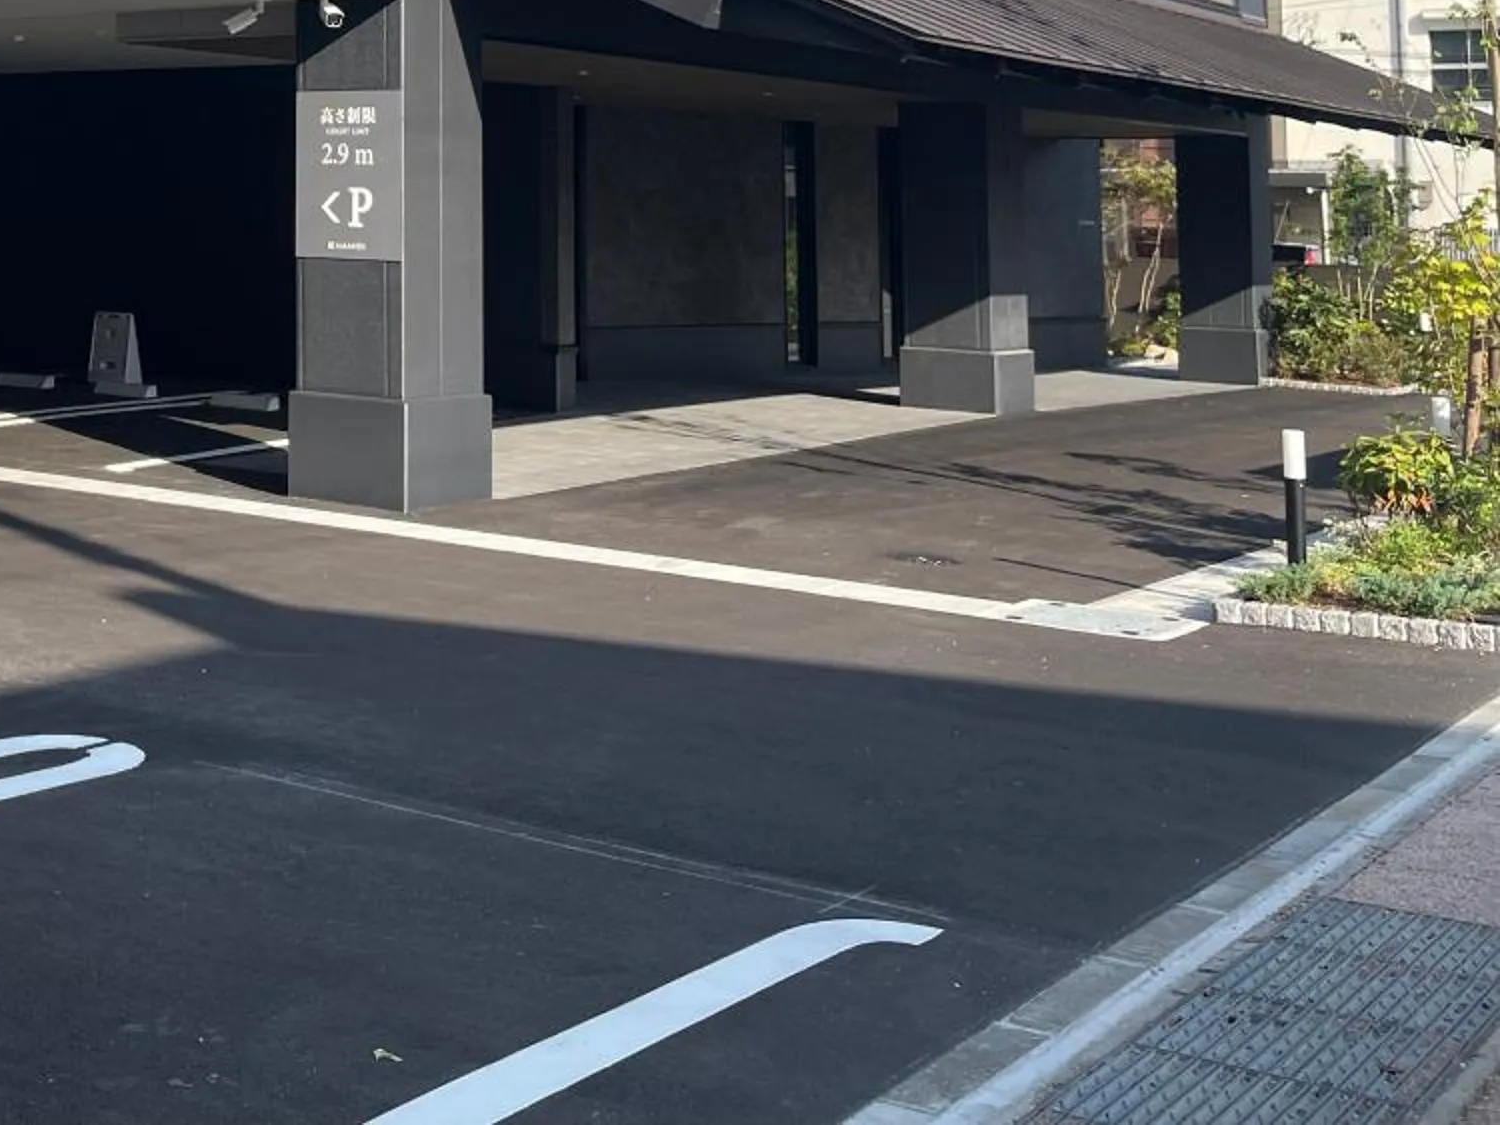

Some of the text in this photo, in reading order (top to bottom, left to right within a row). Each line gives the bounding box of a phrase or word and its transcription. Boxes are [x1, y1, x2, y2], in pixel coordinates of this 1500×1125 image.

[320, 106, 376, 124] 高さ制限
[321, 142, 374, 165] 2.9 m
[347, 186, 373, 228] P
